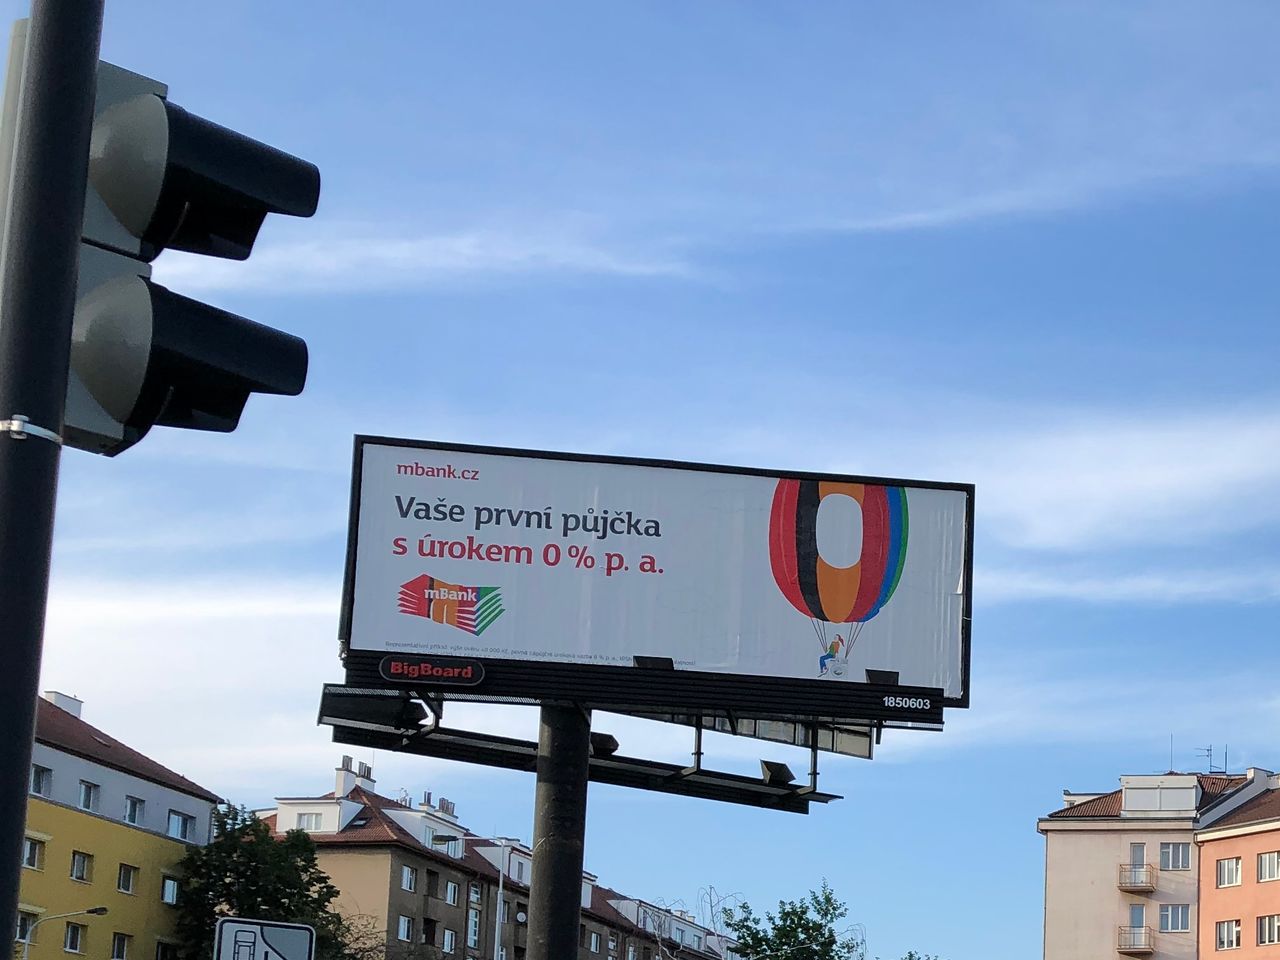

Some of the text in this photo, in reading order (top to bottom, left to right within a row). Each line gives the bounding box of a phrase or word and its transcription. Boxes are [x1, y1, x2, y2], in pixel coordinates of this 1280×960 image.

[396, 461, 480, 481] mbank.cz
[394, 495, 662, 540] Vaše první půjčka
[392, 533, 664, 577] s úrokem 0 % p. a.
[423, 587, 478, 602] mBank
[390, 661, 474, 679] BigBoard
[882, 696, 931, 709] 1850603
